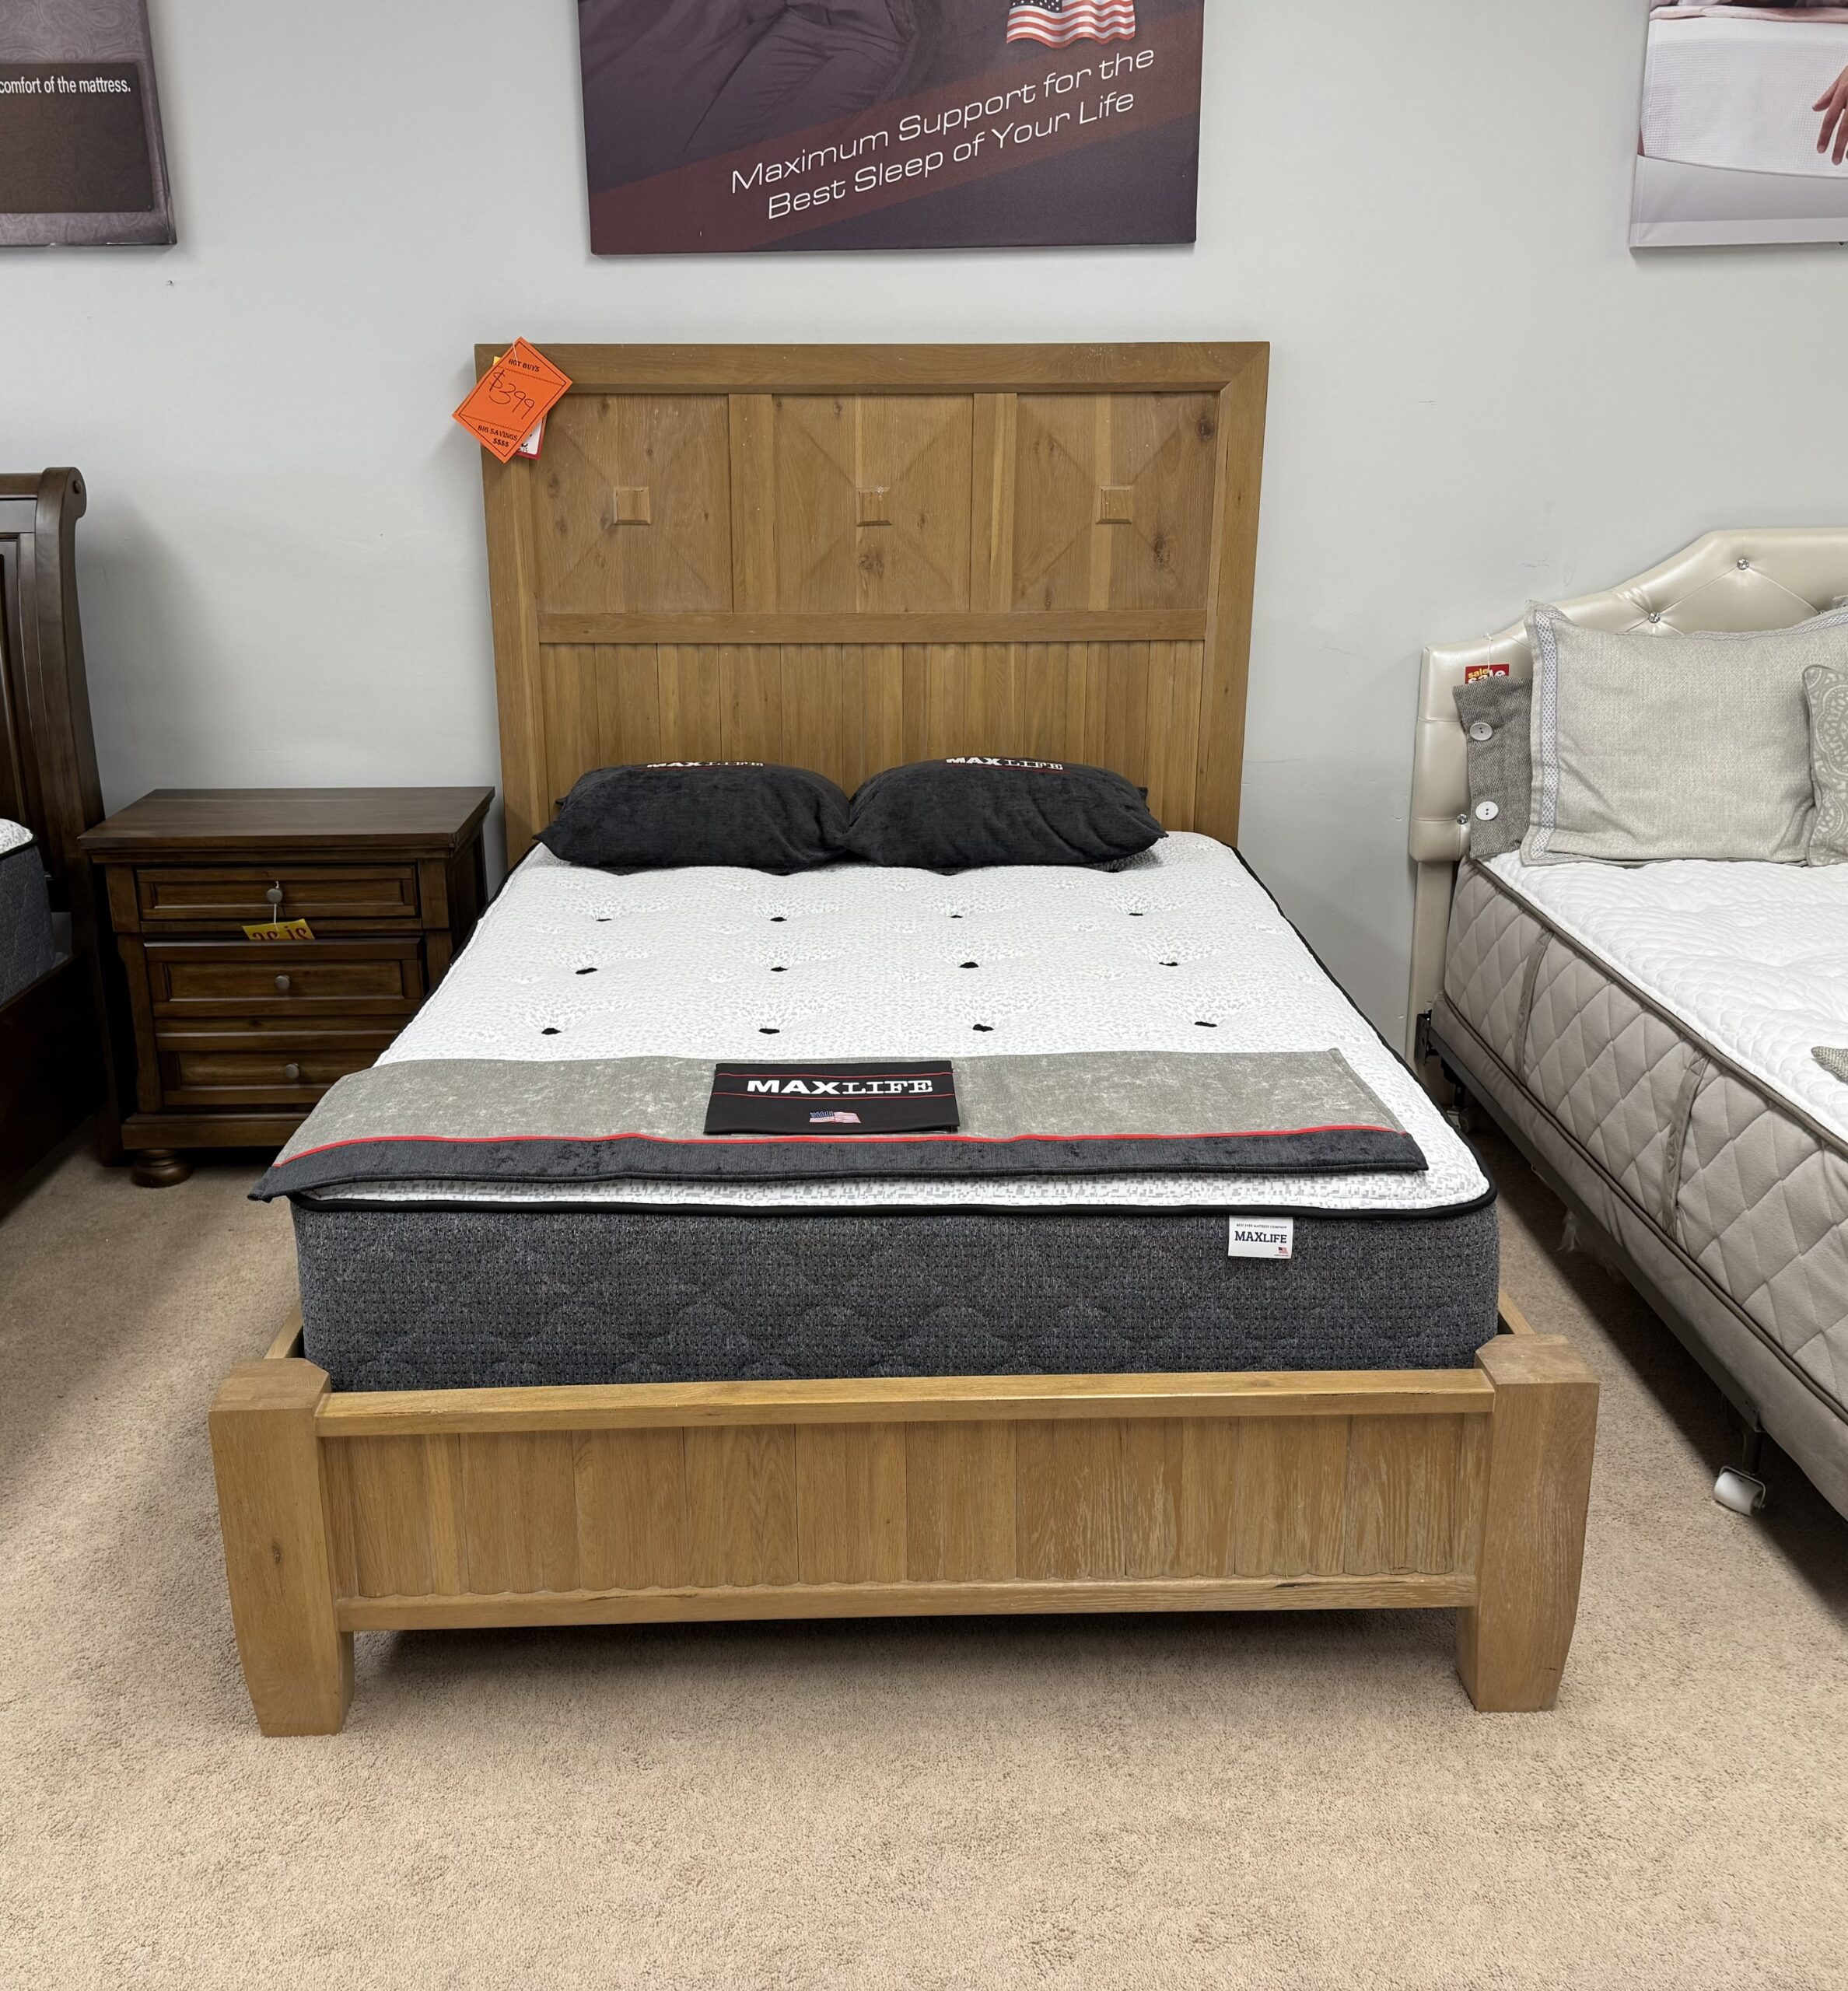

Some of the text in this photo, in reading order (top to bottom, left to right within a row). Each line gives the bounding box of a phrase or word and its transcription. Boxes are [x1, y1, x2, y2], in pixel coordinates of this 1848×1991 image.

[0, 75, 131, 94] comfort of the mattress.
[732, 49, 1154, 194] Maximum Support for the
[768, 91, 1134, 219] Best Sleep of Your Life
[523, 362, 541, 372] BUYS
[488, 369, 535, 420] $399
[478, 425, 518, 441] BIG SAVINGS
[1468, 668, 1489, 679] sale
[747, 1079, 933, 1095] MAXLIFE
[1234, 1230, 1287, 1244] MAXLIFE
